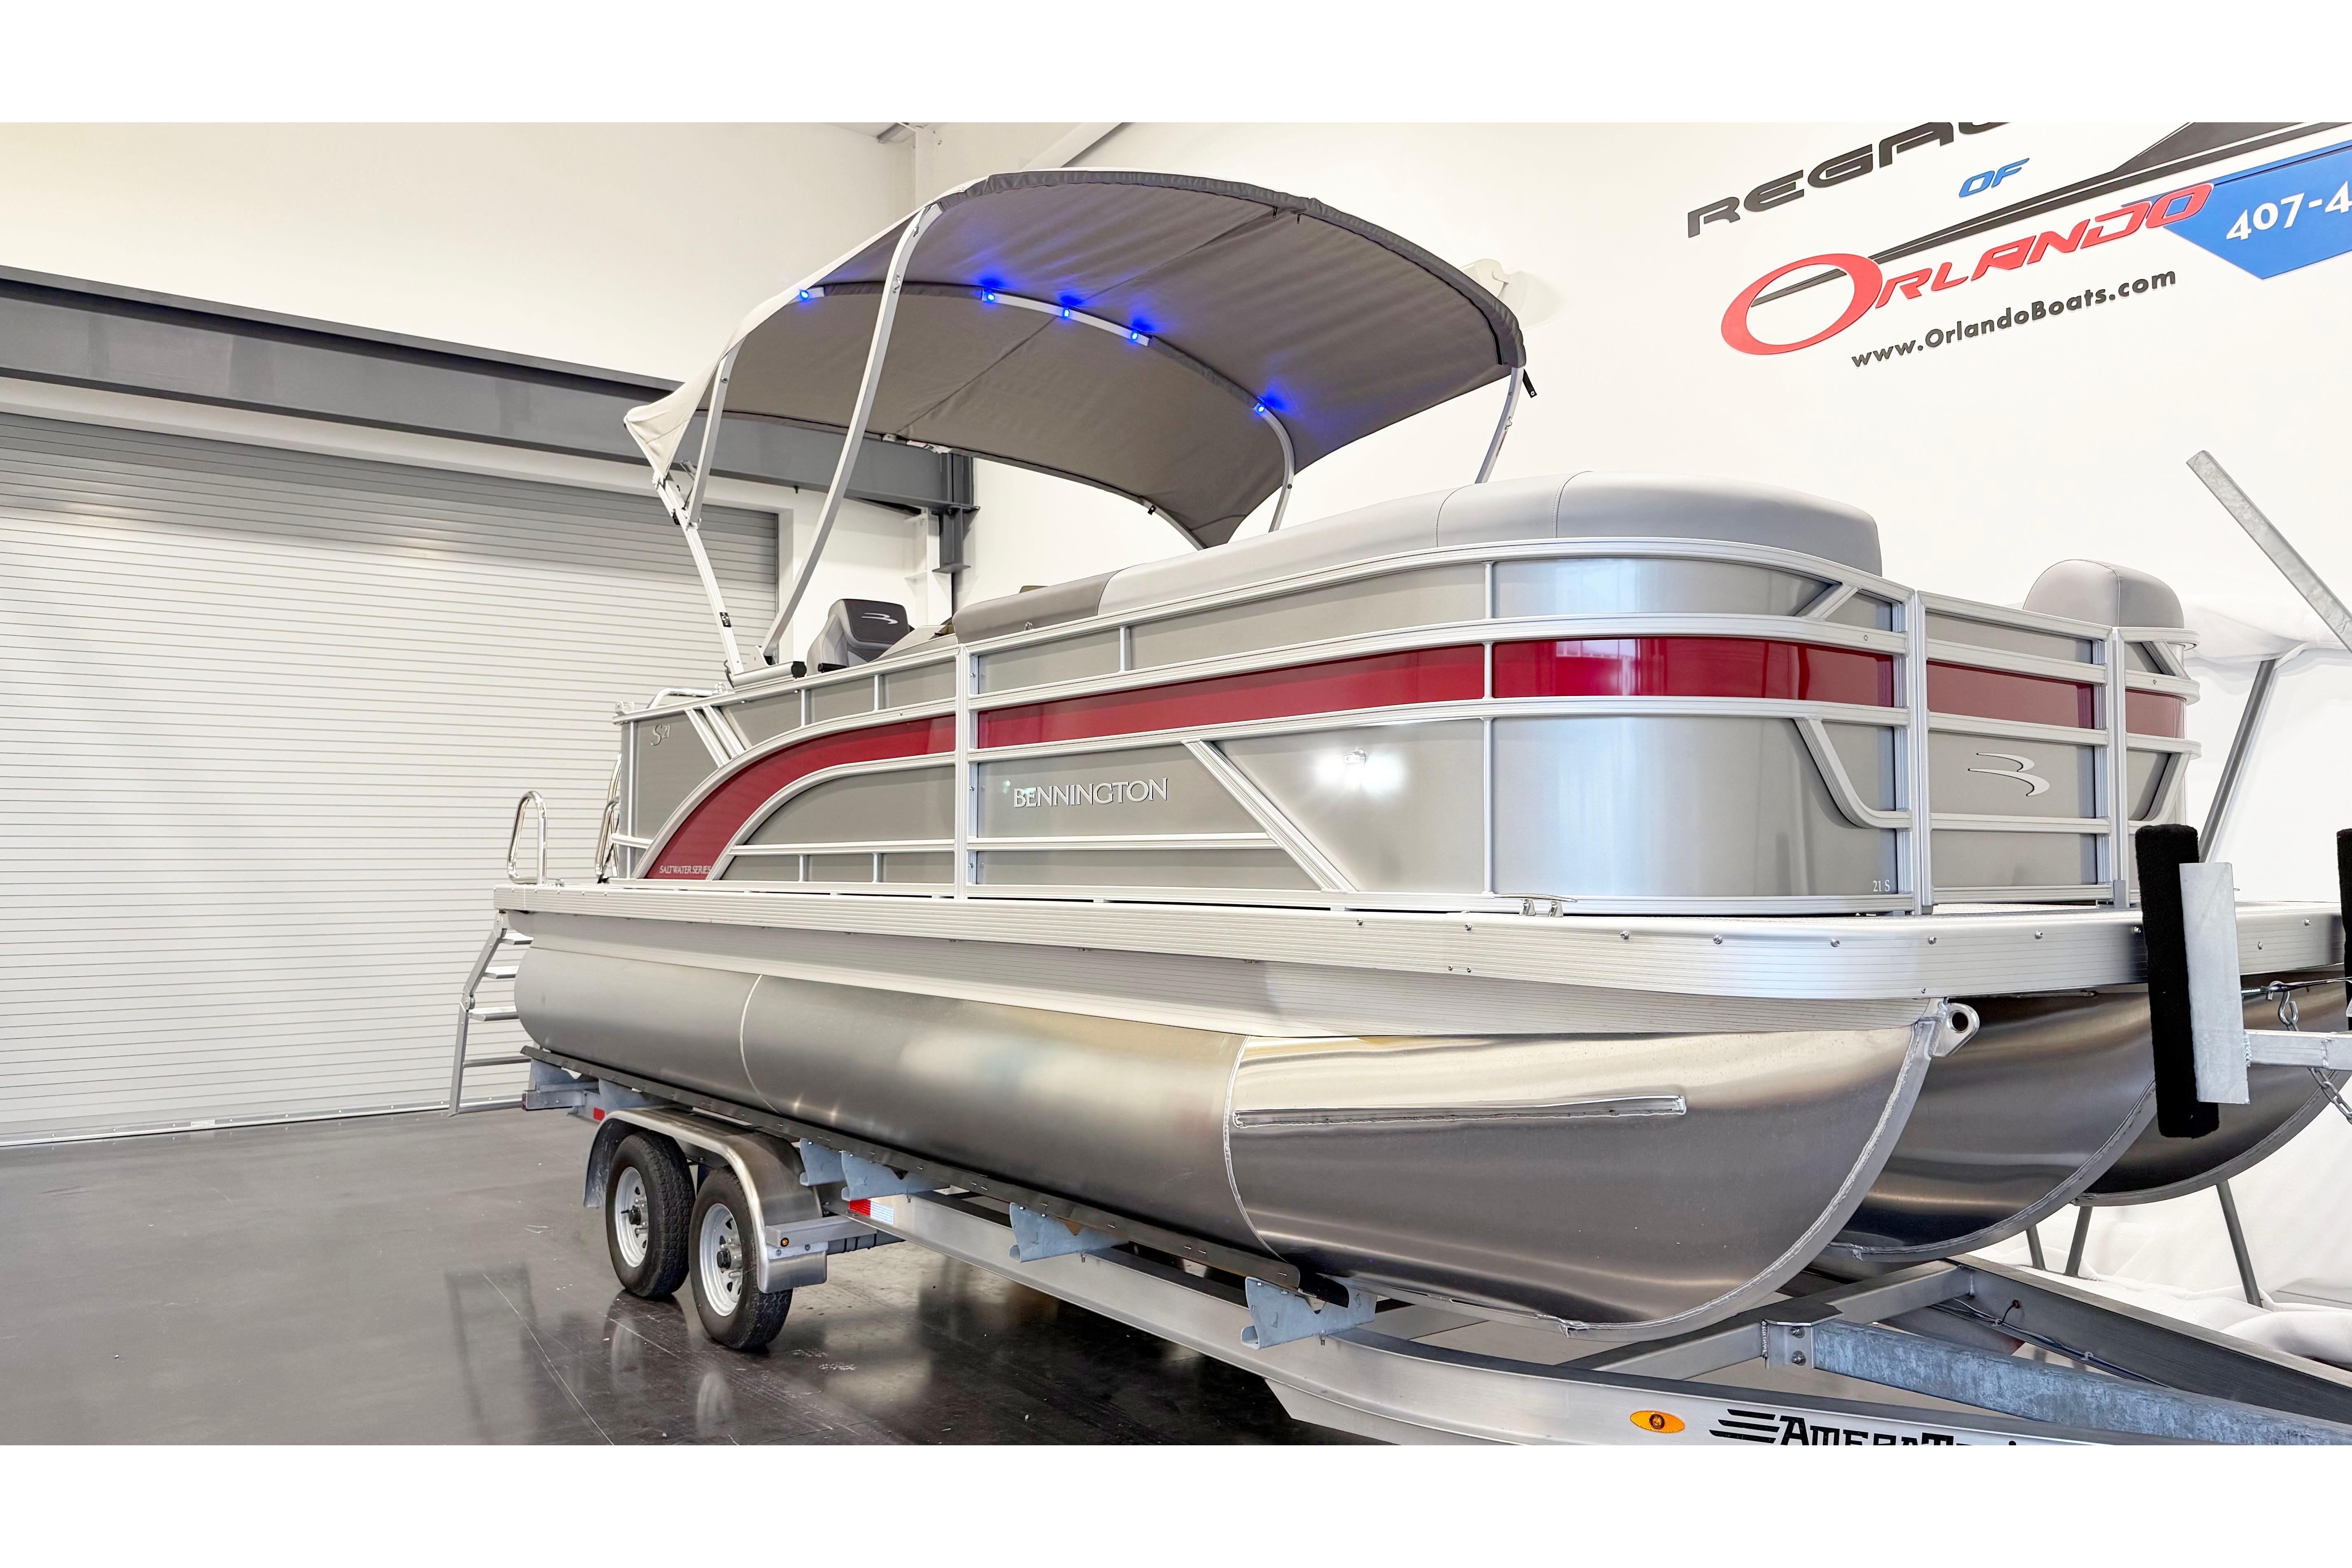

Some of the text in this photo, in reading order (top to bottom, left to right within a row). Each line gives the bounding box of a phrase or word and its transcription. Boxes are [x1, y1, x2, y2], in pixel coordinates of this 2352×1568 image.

[1959, 158, 2030, 198] OF
[2226, 181, 2352, 240] 407-4
[1721, 184, 2213, 355] ORLANDO
[1851, 271, 2176, 367] www.OrlandoBoats.com
[1014, 778, 1167, 807] BENNINGTON
[692, 865, 712, 874] SERIES
[1873, 880, 1890, 892] 21 S
